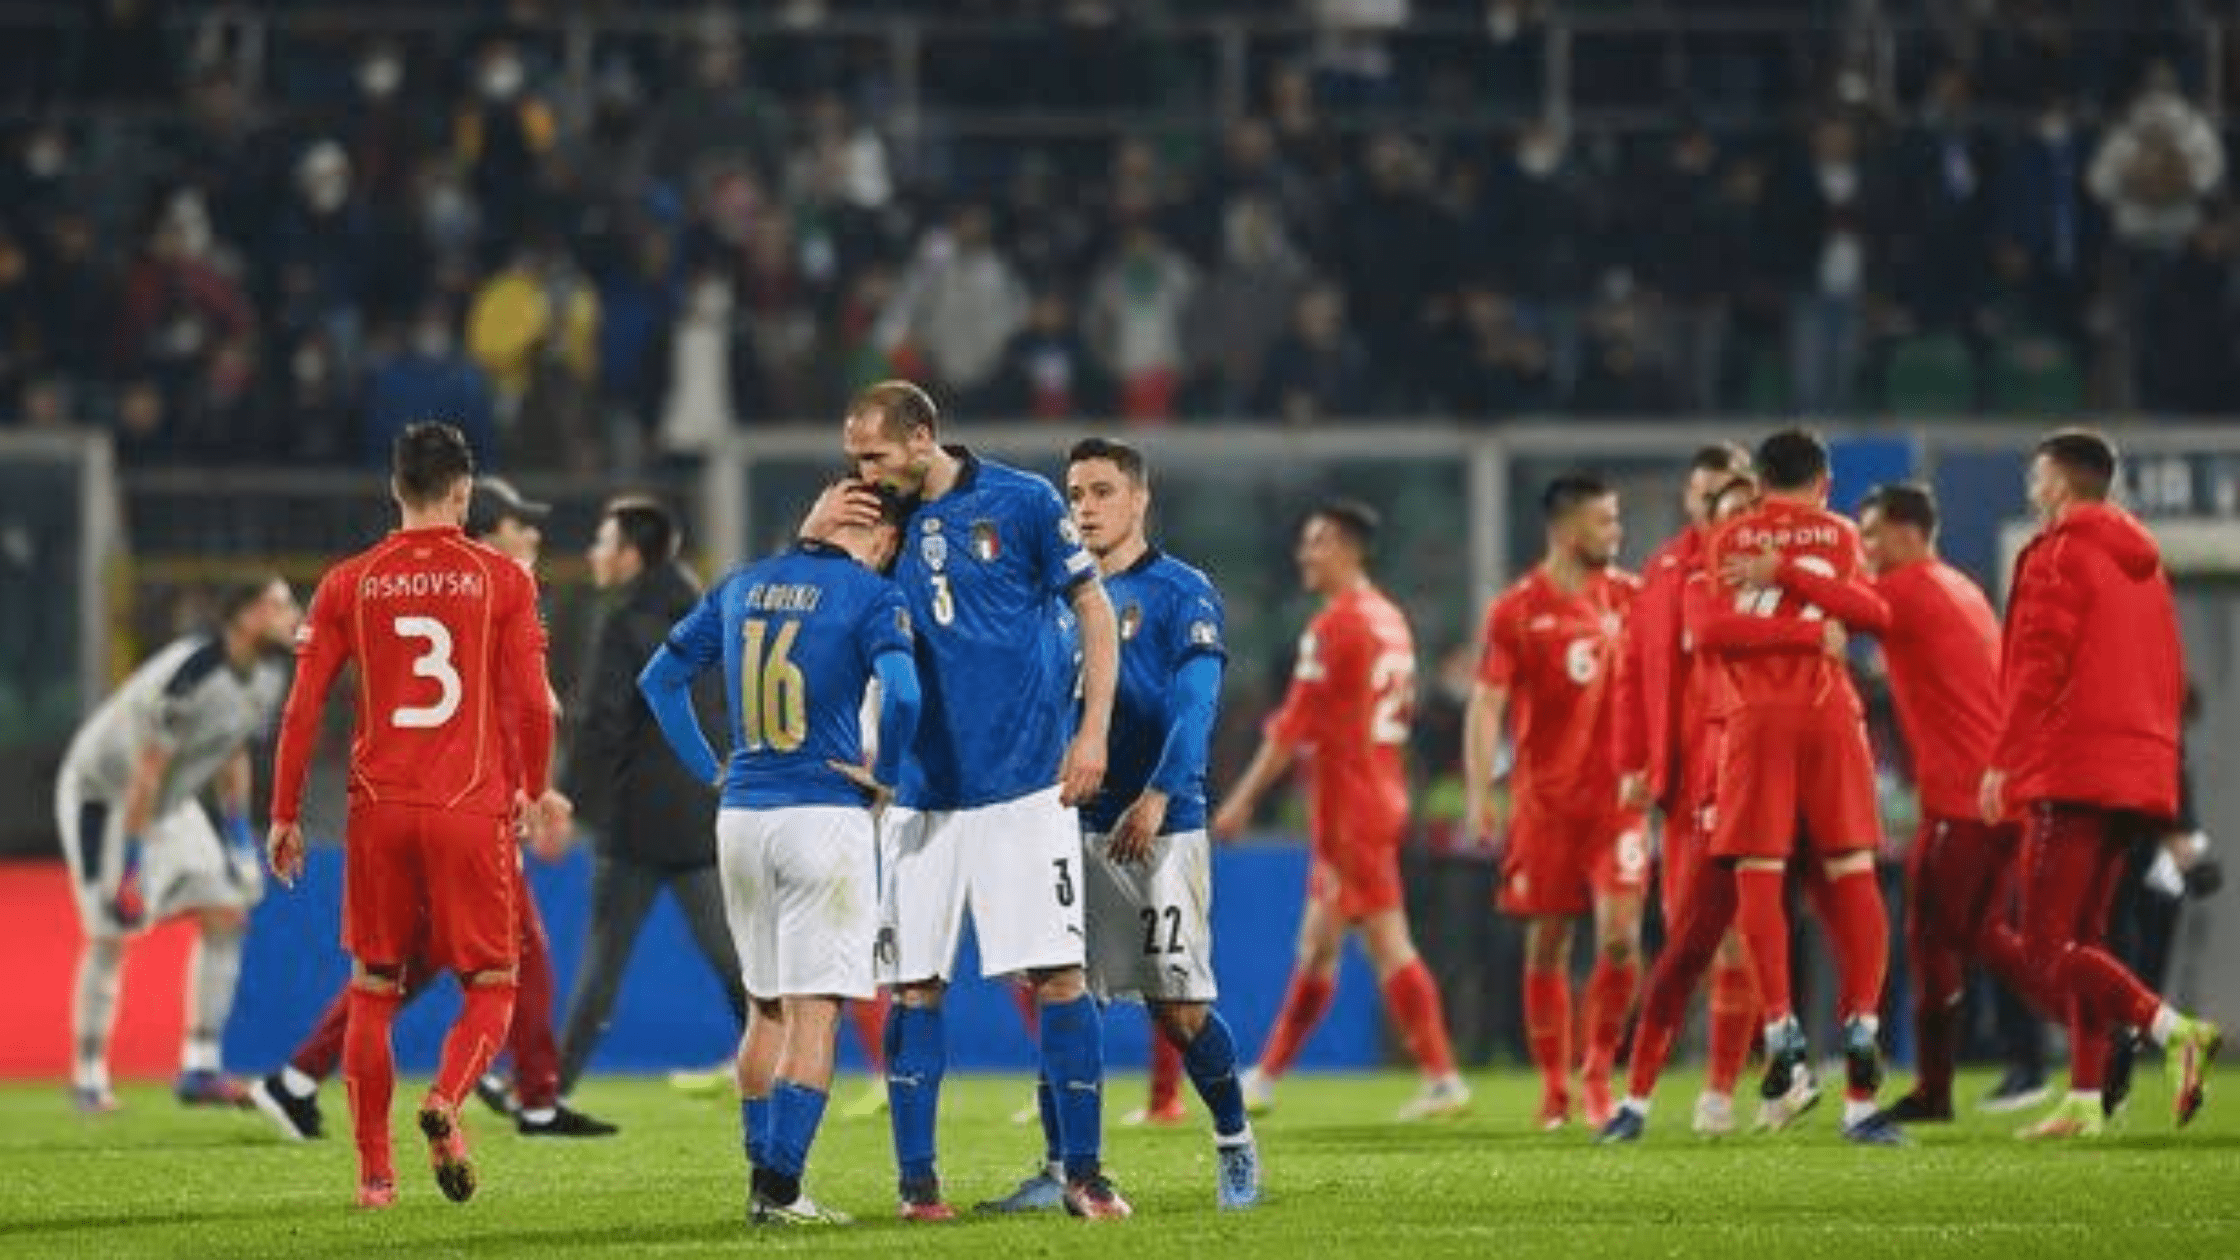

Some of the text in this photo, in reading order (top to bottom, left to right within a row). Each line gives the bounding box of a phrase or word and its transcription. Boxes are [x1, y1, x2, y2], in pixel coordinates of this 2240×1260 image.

[931, 575, 955, 626] 3
[390, 615, 464, 729] 3
[741, 619, 806, 752] 16
[1567, 638, 1599, 684] 6
[1617, 829, 1645, 873] 6
[1053, 857, 1075, 908] 3
[1139, 905, 1185, 956] 22
